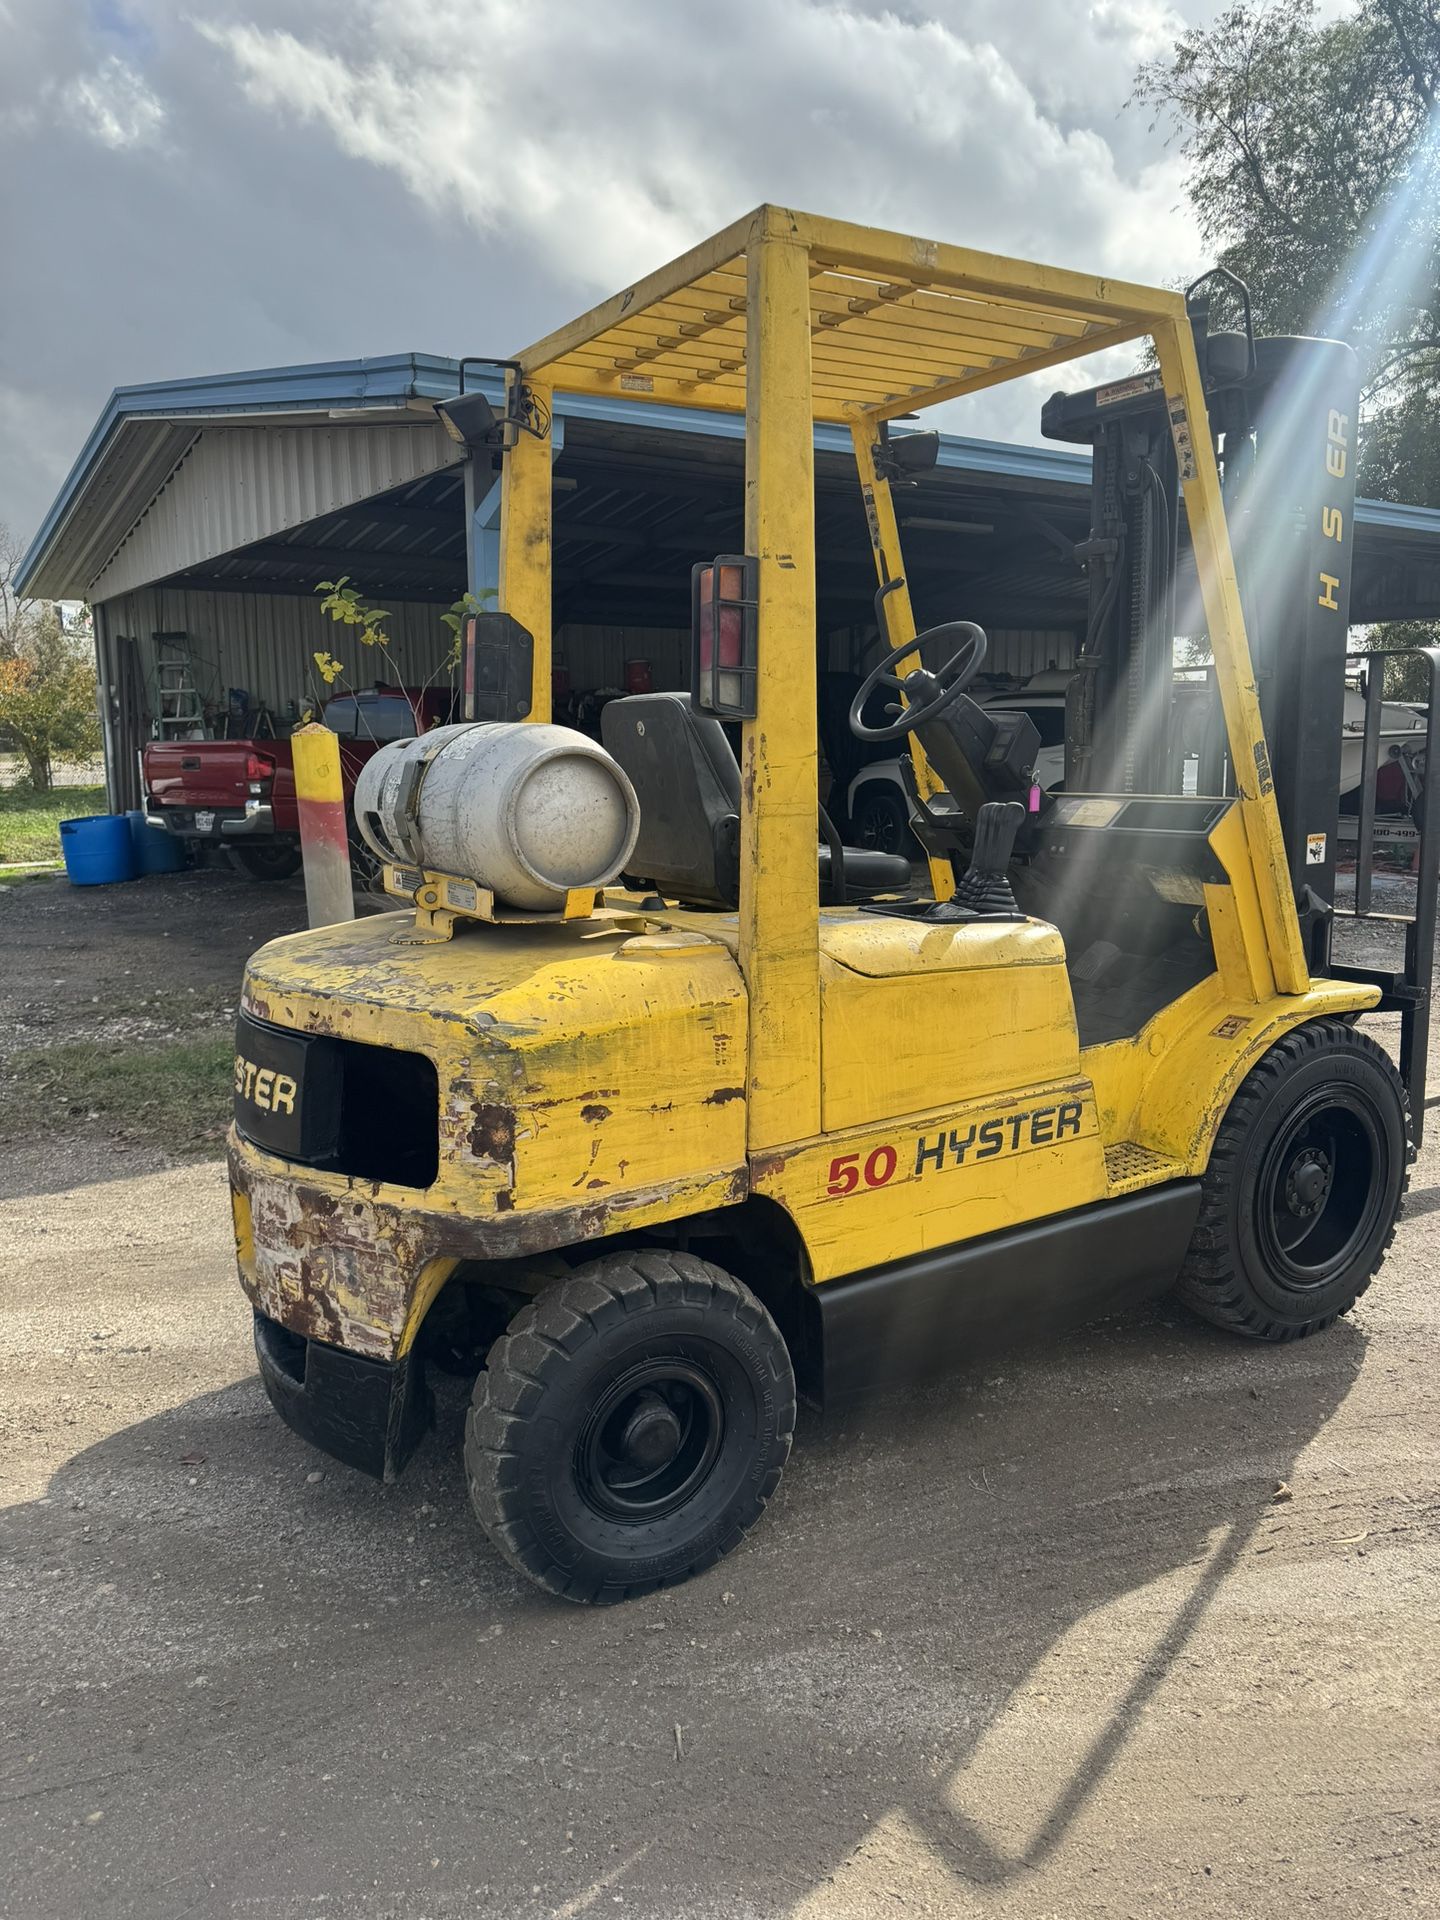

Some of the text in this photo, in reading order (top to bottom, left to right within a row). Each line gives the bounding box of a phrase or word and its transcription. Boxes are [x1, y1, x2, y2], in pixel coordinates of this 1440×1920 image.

[827, 1100, 1083, 1196] 50 HYSTER
[727, 1328, 768, 1386] INDUSTRIAL
